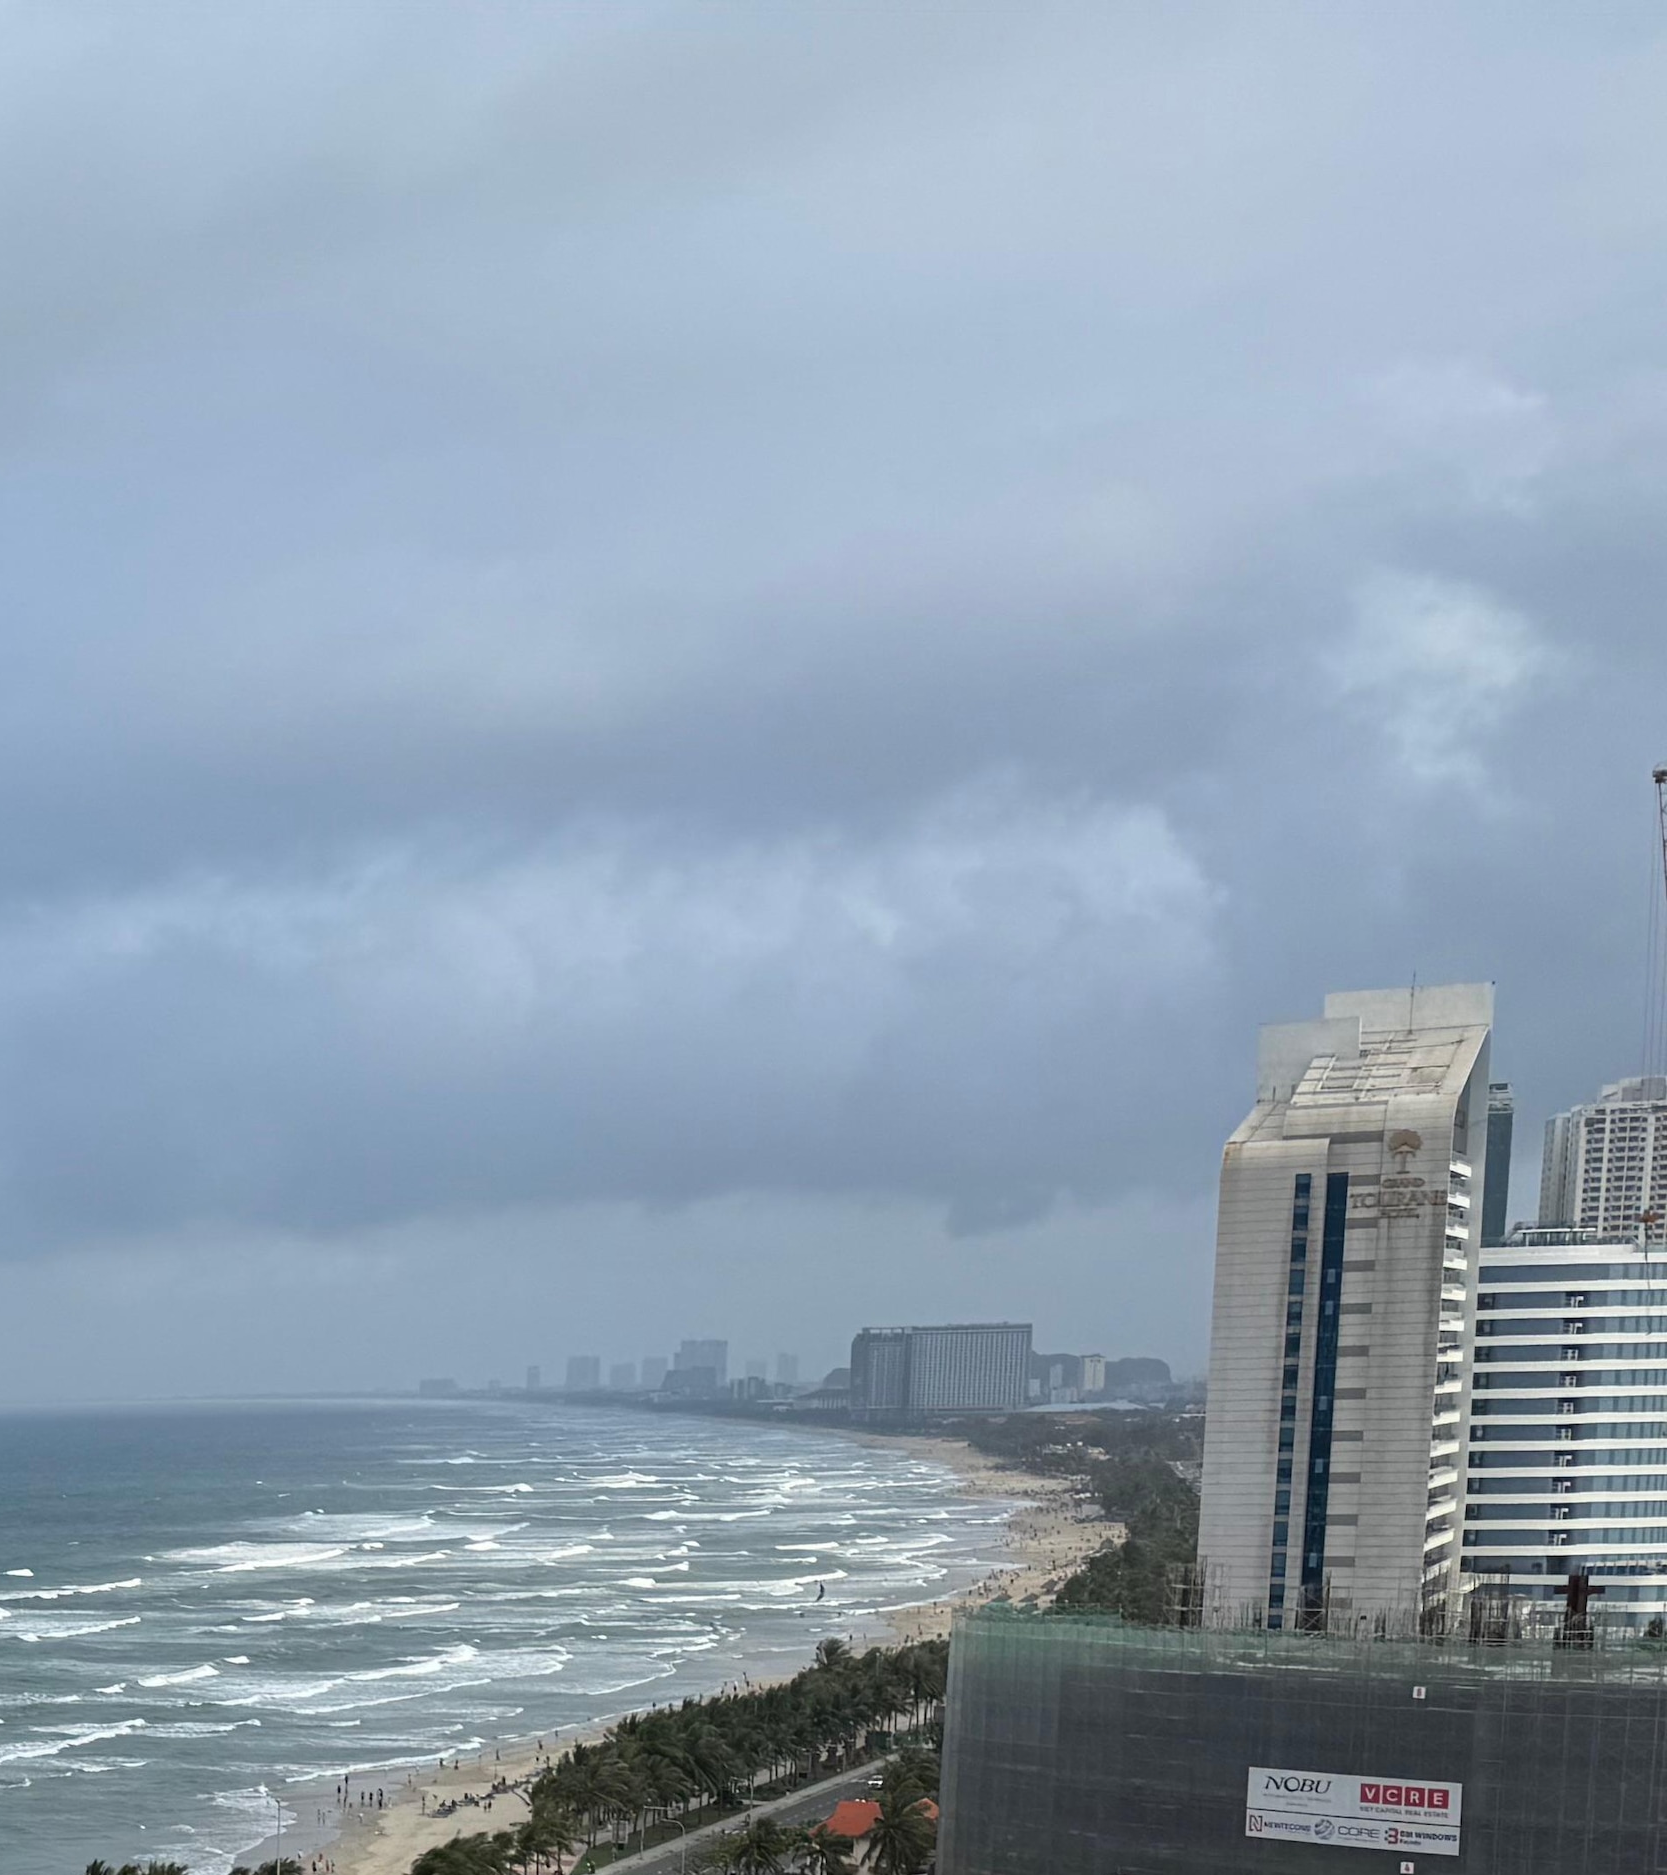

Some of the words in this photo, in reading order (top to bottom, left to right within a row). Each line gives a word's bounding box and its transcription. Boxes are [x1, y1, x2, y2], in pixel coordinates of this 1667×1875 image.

[1265, 1776, 1332, 1794] NOBU
[1364, 1787, 1444, 1805] VCRE
[1338, 1826, 1381, 1839] CORE
[1414, 1832, 1457, 1842] WINDOWS
